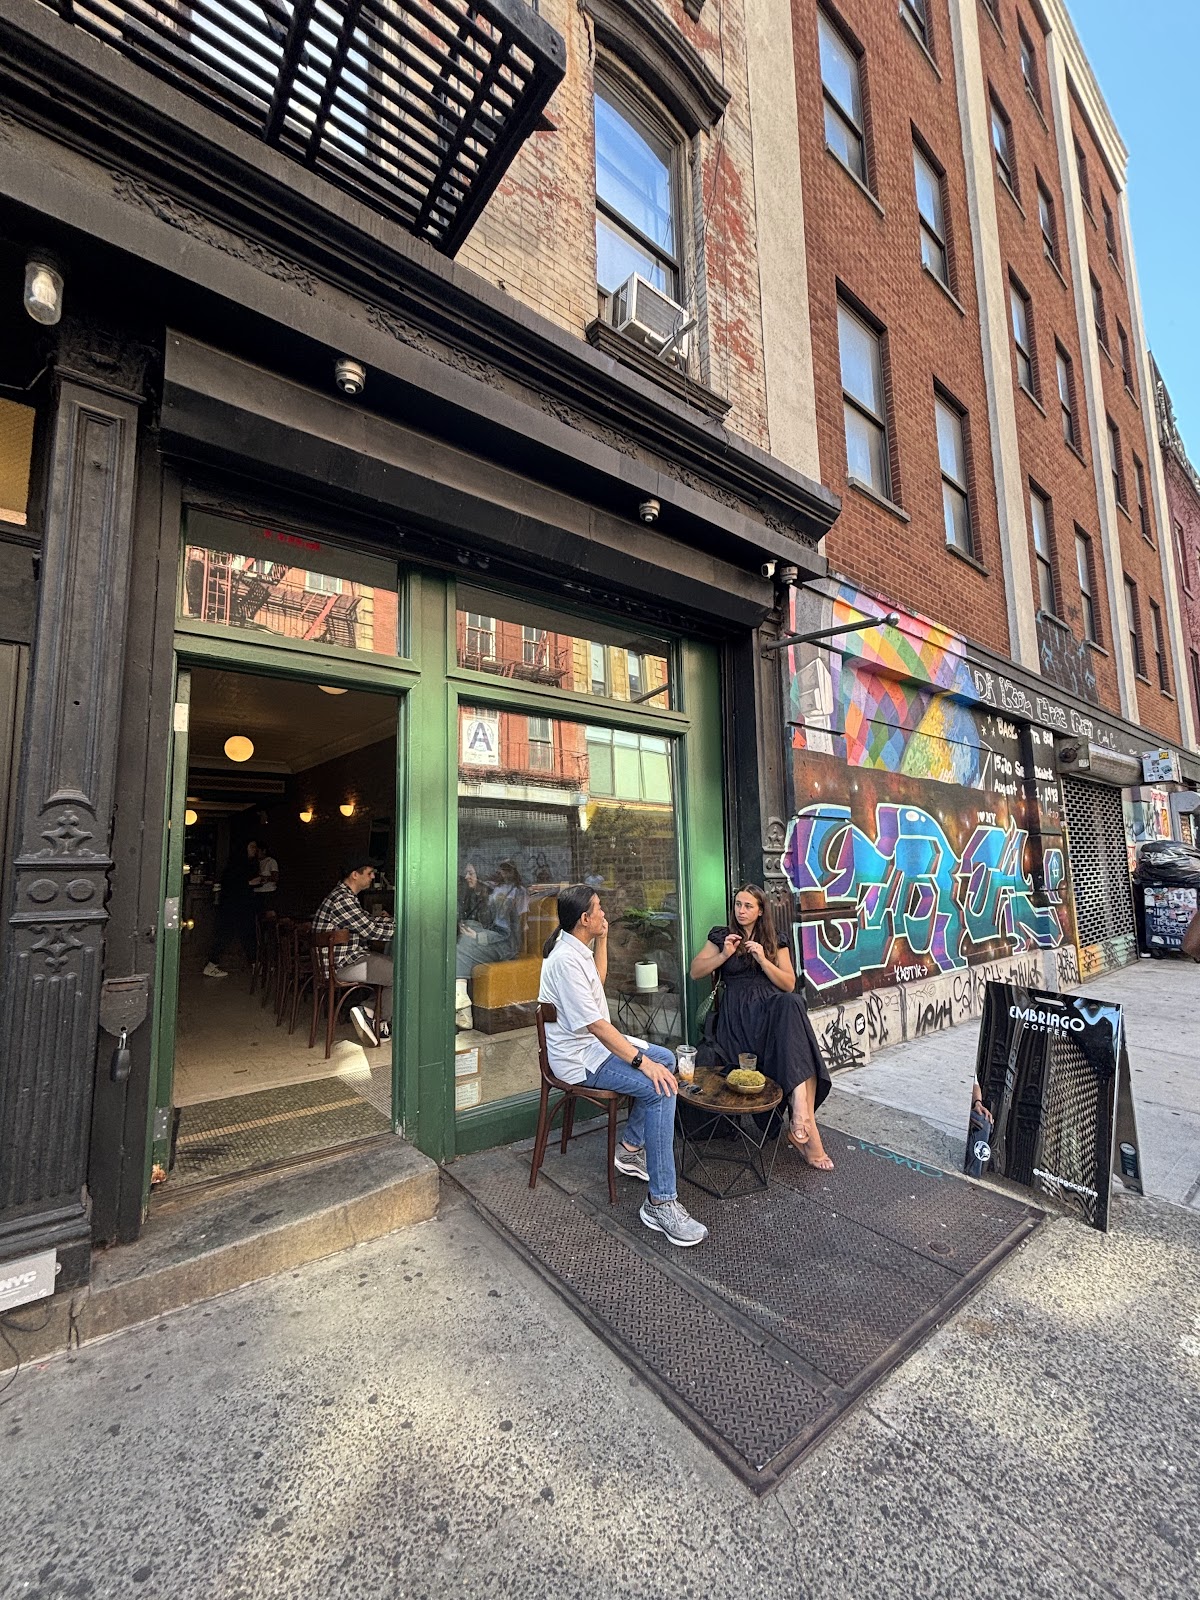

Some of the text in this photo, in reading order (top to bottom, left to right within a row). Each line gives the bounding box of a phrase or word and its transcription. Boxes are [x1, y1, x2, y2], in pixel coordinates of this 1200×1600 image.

[469, 722, 492, 751] A
[1009, 1006, 1085, 1032] EMBRIAGO
[1023, 1022, 1068, 1038] COFFEE
[1033, 1168, 1098, 1197] @embriagocoffee
